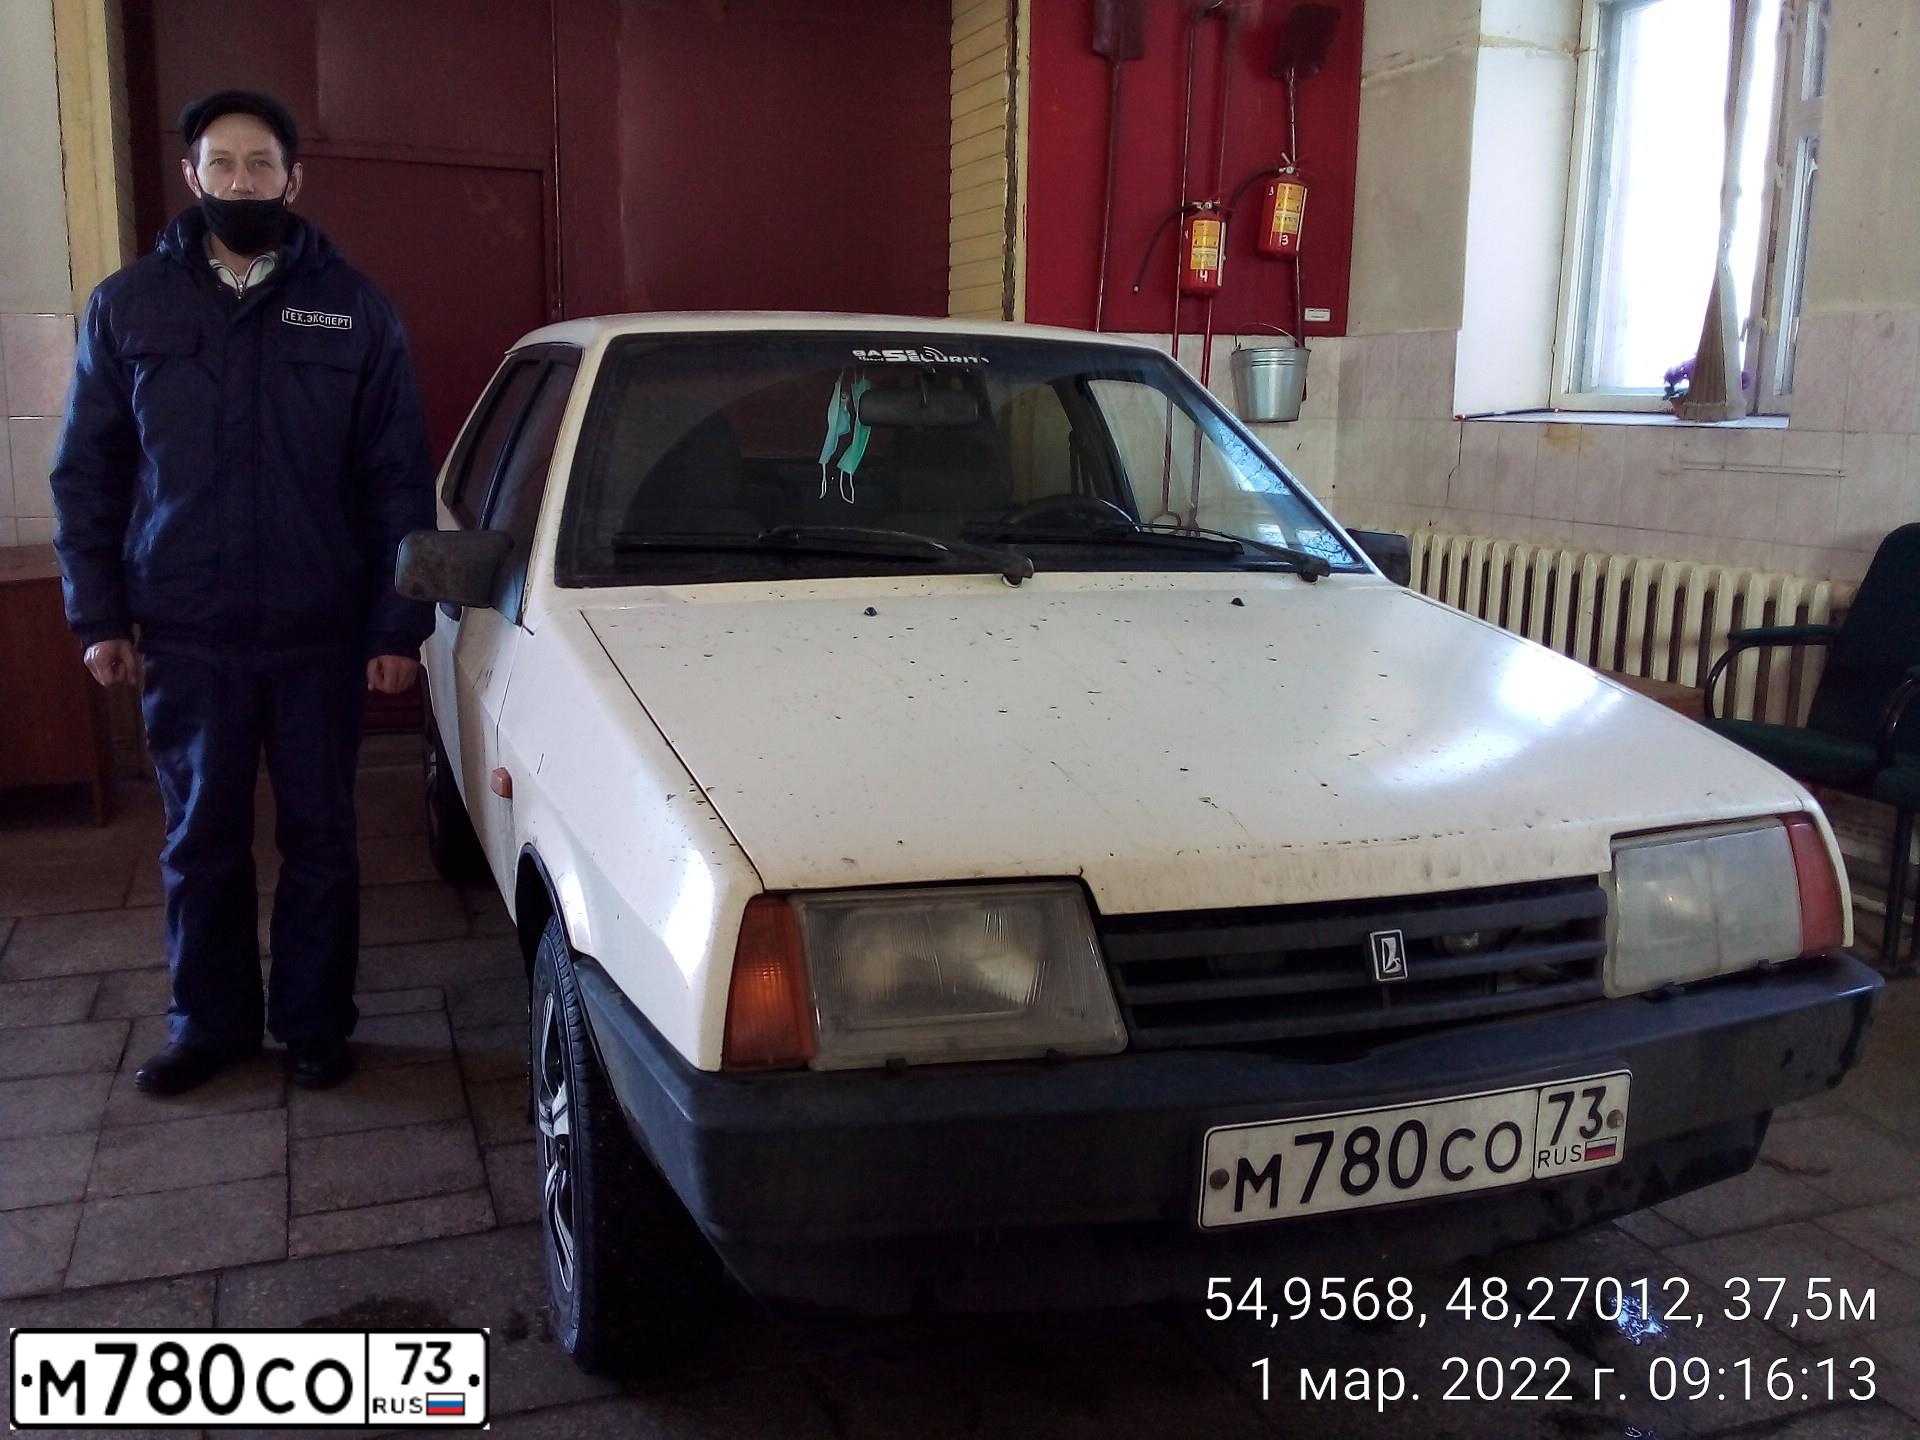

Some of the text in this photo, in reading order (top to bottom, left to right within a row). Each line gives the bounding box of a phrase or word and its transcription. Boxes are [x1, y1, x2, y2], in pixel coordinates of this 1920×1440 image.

[1281, 234, 1289, 245] 3
[1199, 269, 1208, 282] 4
[285, 310, 349, 327] ТЕХ.ЭКСПЕРТ
[1547, 1086, 1607, 1146] 73
[1234, 1119, 1523, 1213] М780СО
[1536, 1144, 1582, 1169] RUS
